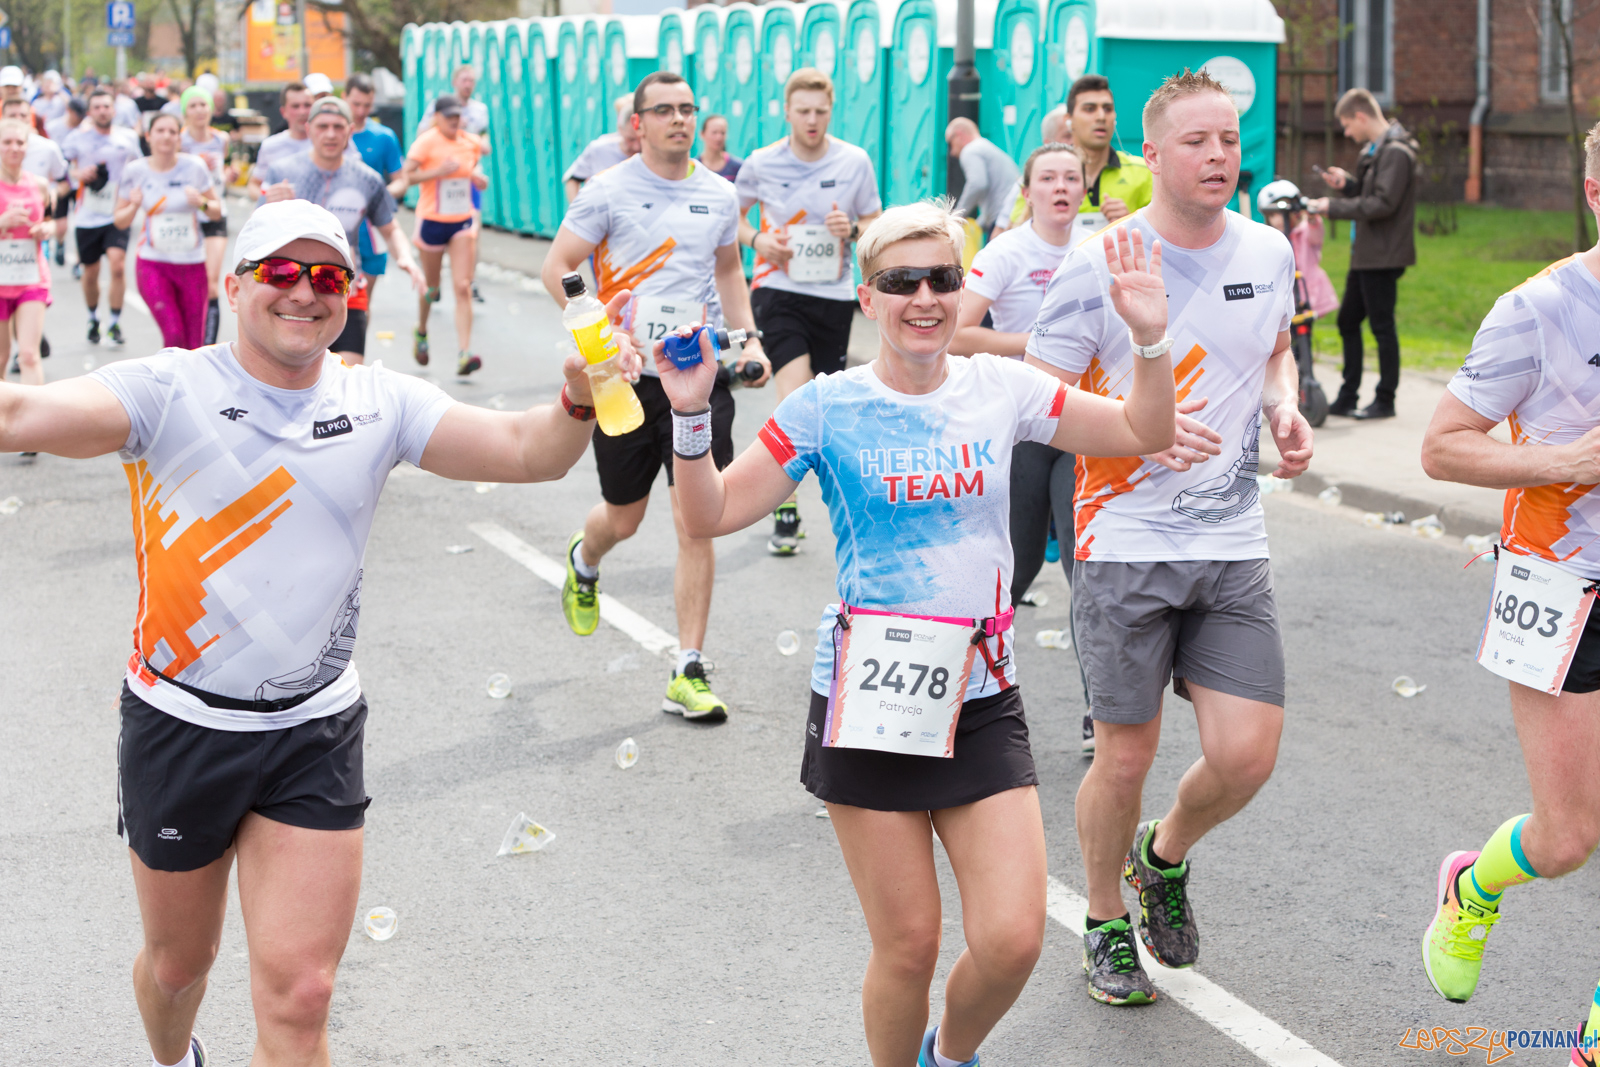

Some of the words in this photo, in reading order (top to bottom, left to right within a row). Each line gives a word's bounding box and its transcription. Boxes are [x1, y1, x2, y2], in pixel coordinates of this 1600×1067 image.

[795, 243, 835, 257] 7608
[1228, 287, 1252, 297] 11.PKO
[647, 322, 677, 340] 12
[219, 407, 248, 421] 4F
[316, 419, 349, 435] 11.PKO
[860, 439, 996, 477] HERNIK
[882, 470, 984, 503] TEAM
[1494, 590, 1563, 638] 4803
[889, 631, 910, 640] 11.PKO
[1499, 630, 1525, 647] MICHAŁ
[859, 658, 949, 700] 2478
[879, 700, 923, 716] Patrycja
